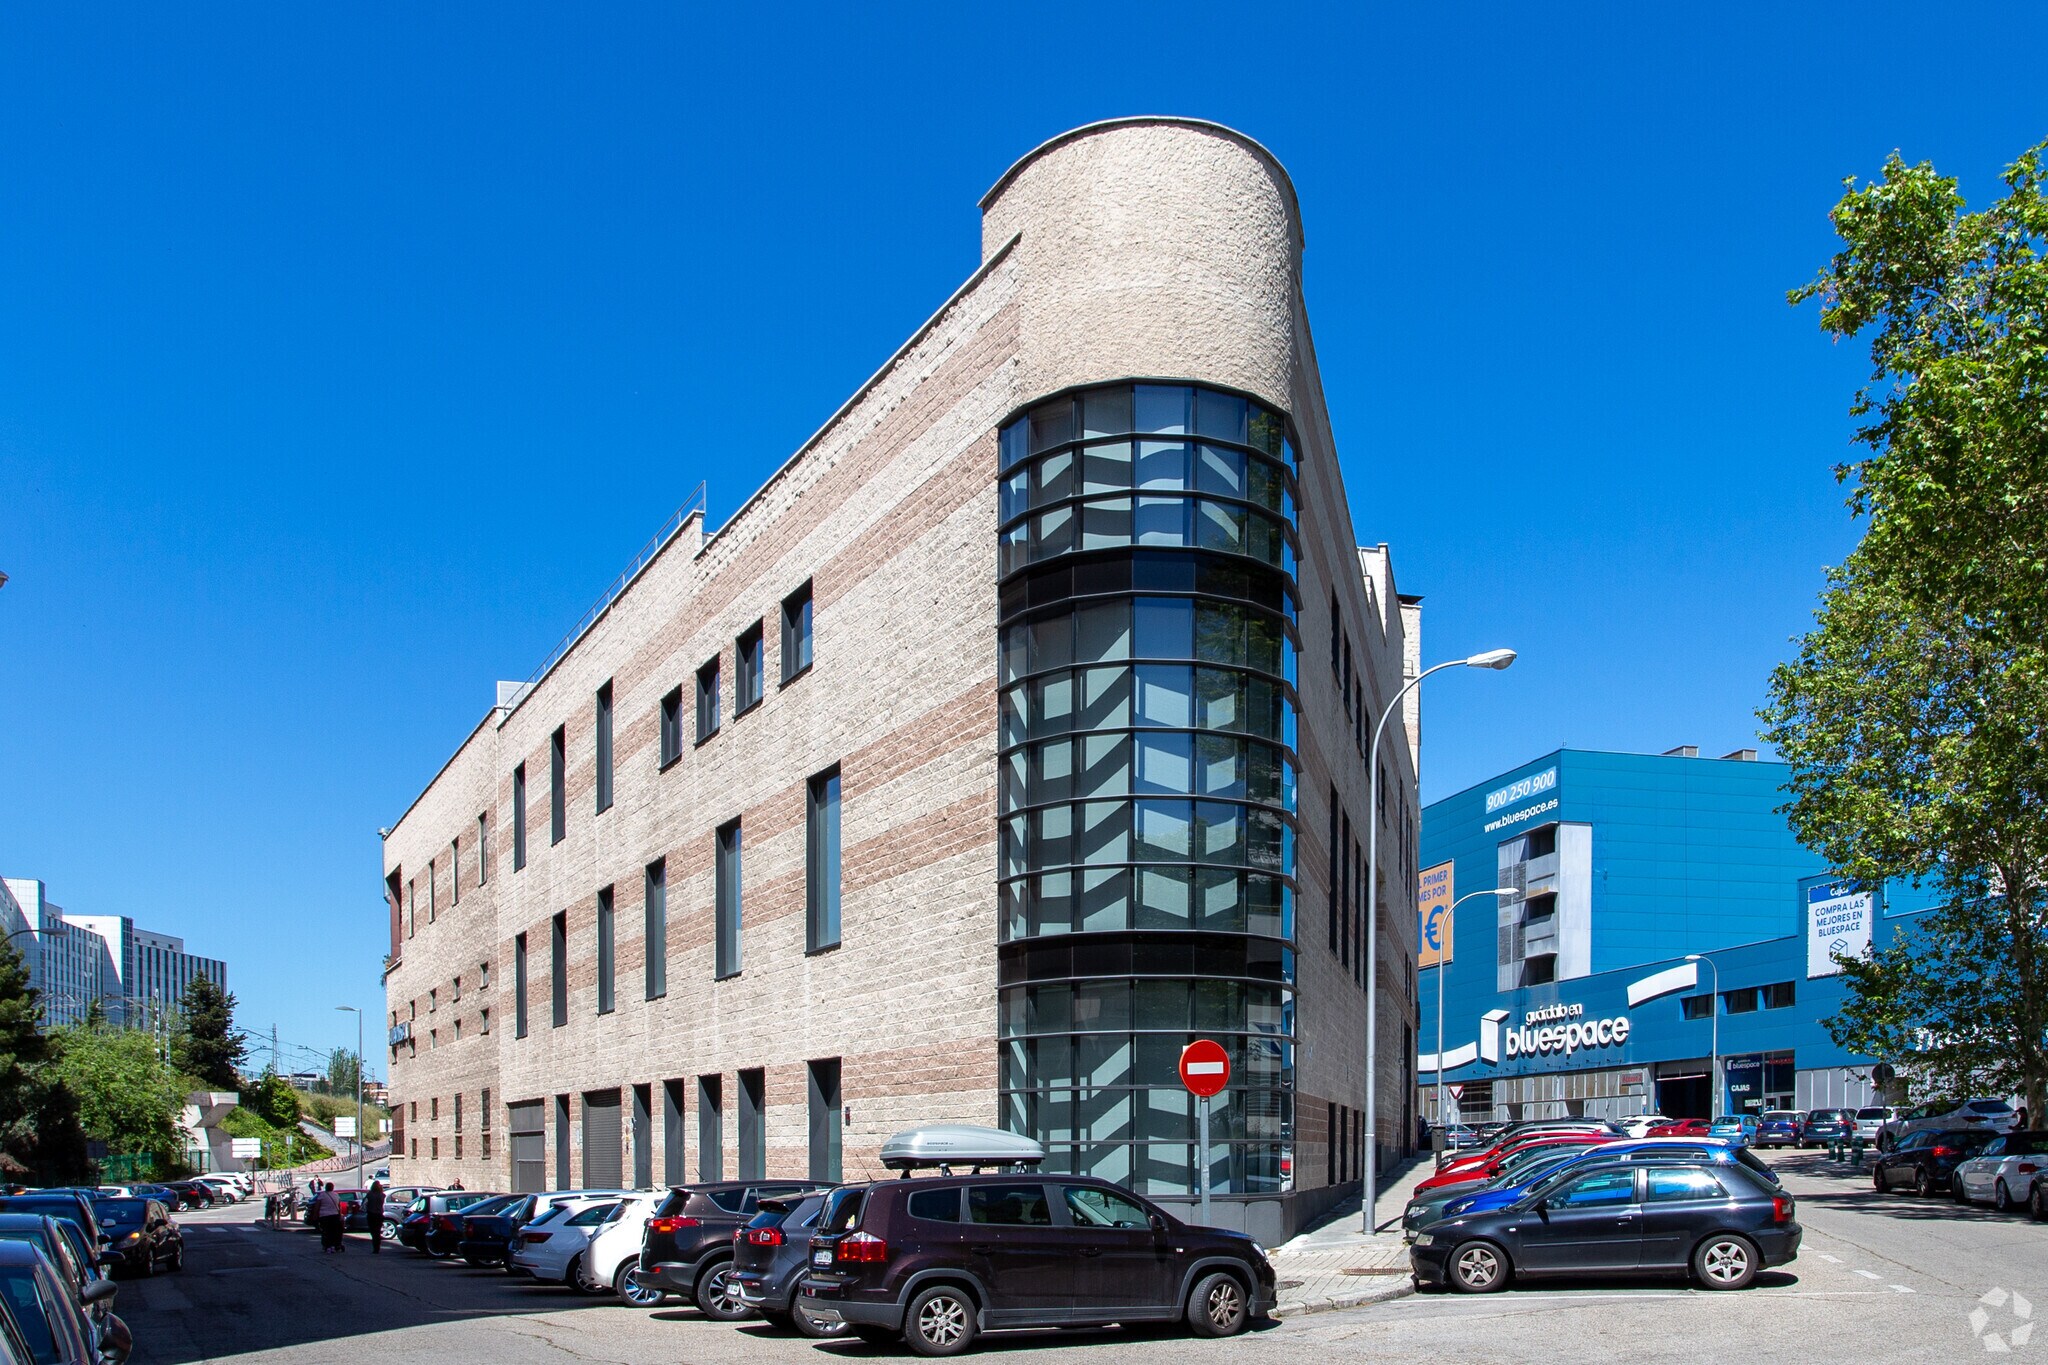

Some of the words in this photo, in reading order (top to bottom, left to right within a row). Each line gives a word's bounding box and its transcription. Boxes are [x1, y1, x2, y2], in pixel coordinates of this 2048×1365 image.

[1487, 794, 1506, 811] 900
[1509, 781, 1530, 801] 250
[1533, 770, 1554, 793] 900
[1484, 798, 1558, 833] www.bluespace.es
[1423, 870, 1447, 887] PRIMER
[1432, 885, 1446, 898] POR
[1815, 903, 1847, 917] COMPRA
[1849, 899, 1864, 910] LAS
[1816, 912, 1850, 927] MEJORES
[1853, 911, 1862, 920] EN
[1819, 921, 1860, 937] BLUESPACE
[1569, 1003, 1583, 1016] en
[1506, 1016, 1629, 1056] bluespace
[1732, 1061, 1760, 1070] bluespace
[1731, 1084, 1750, 1092] CAJAS
